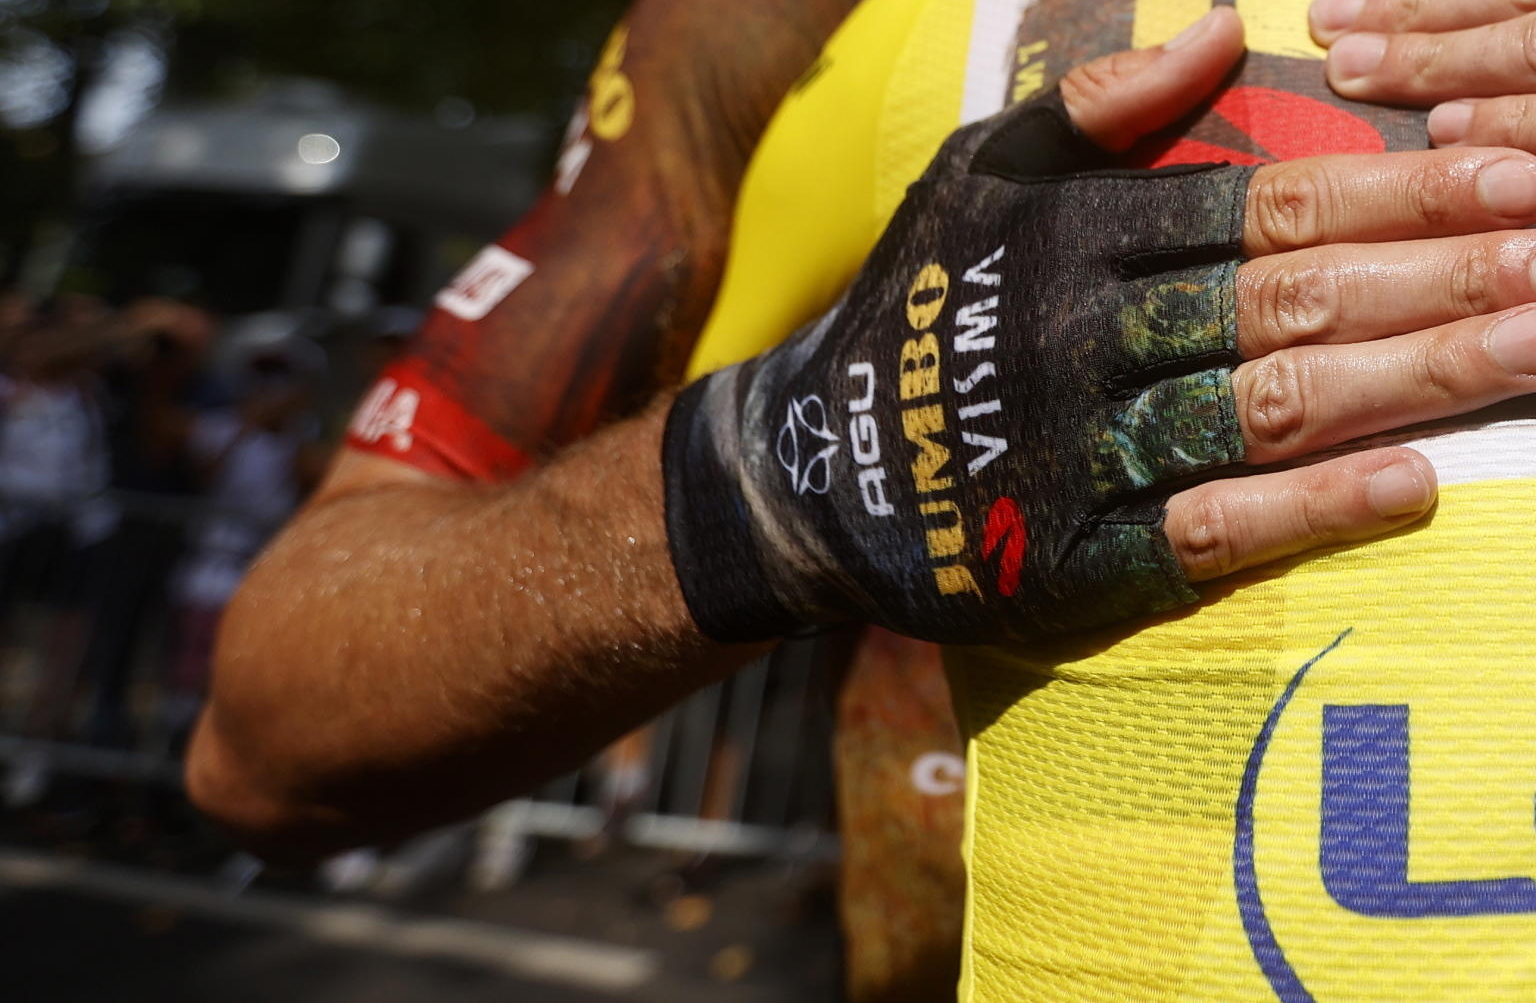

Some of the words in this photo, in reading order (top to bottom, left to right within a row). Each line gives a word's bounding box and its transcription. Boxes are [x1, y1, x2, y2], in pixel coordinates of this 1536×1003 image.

[848, 361, 895, 517] AGU
[900, 263, 985, 604] JUMBO
[953, 245, 1009, 476] VISMA
